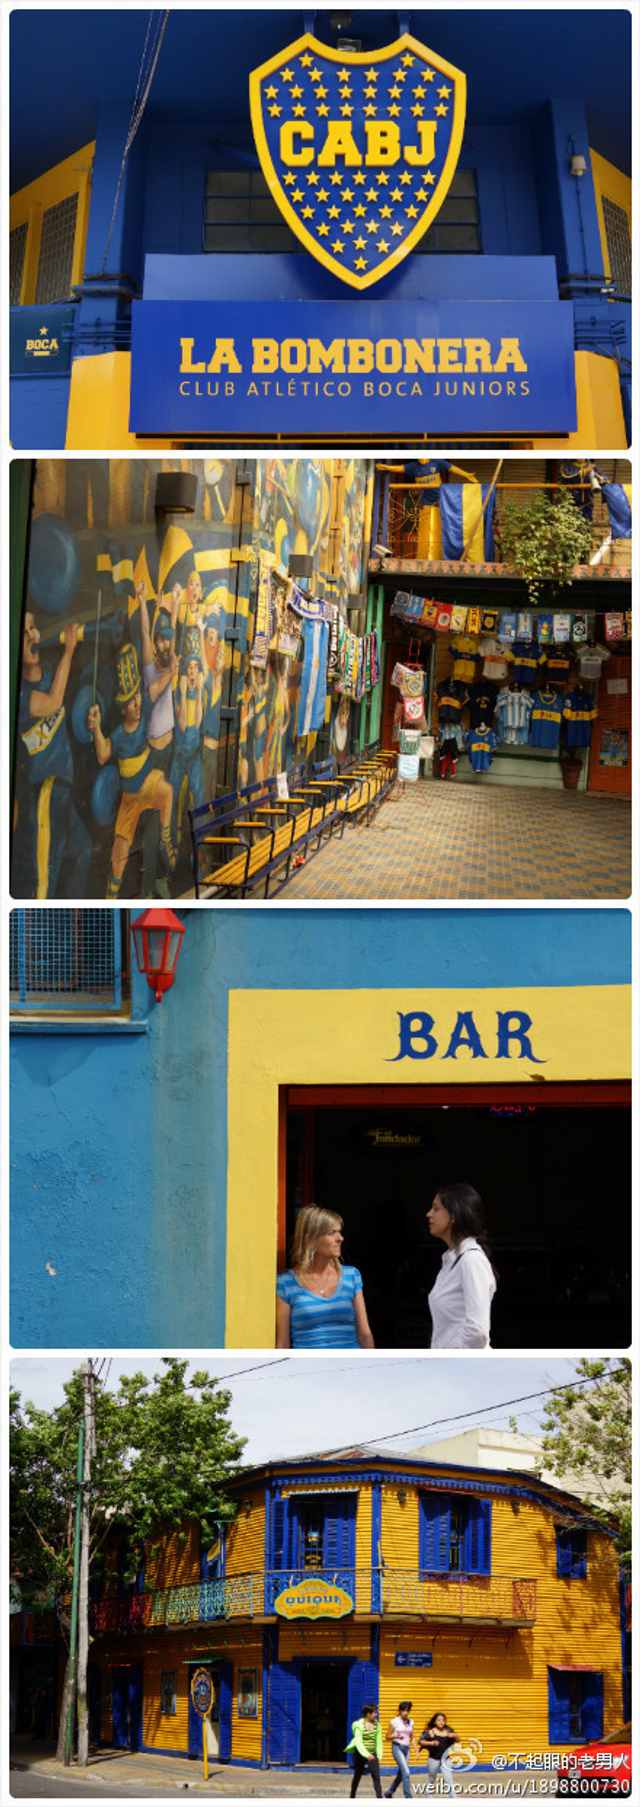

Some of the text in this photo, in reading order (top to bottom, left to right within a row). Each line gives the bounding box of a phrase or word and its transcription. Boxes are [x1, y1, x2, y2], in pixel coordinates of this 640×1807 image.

[280, 120, 437, 166] CABJ
[26, 338, 59, 350] BOCA
[179, 337, 528, 373] LA BOMBONERA
[179, 378, 530, 396] CLUB ATLÉTICO BOCA JUNIORS
[384, 1011, 549, 1063] BAR
